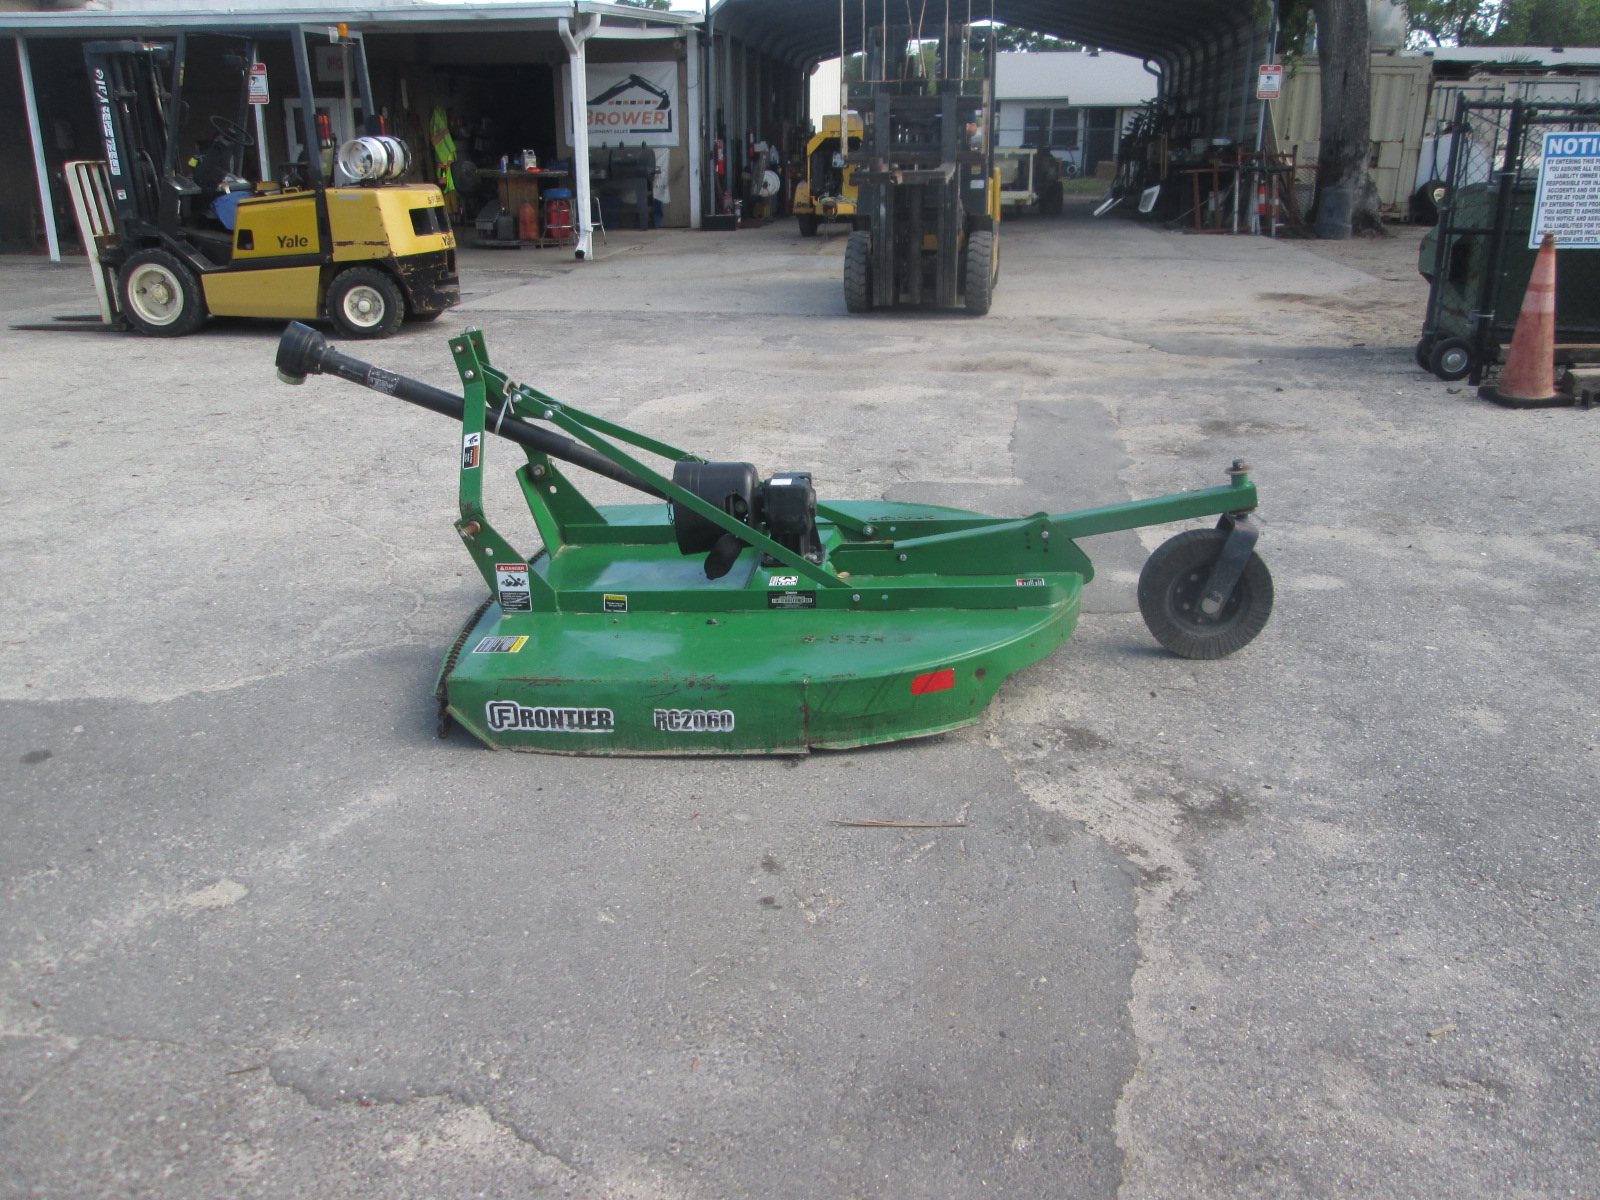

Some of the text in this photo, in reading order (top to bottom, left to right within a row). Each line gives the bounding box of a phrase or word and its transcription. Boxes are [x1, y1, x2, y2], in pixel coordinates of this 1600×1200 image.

[1547, 137, 1600, 155] NOTI
[277, 234, 309, 248] Yale
[487, 701, 615, 731] FRONTIER
[655, 709, 735, 732] RC2060
